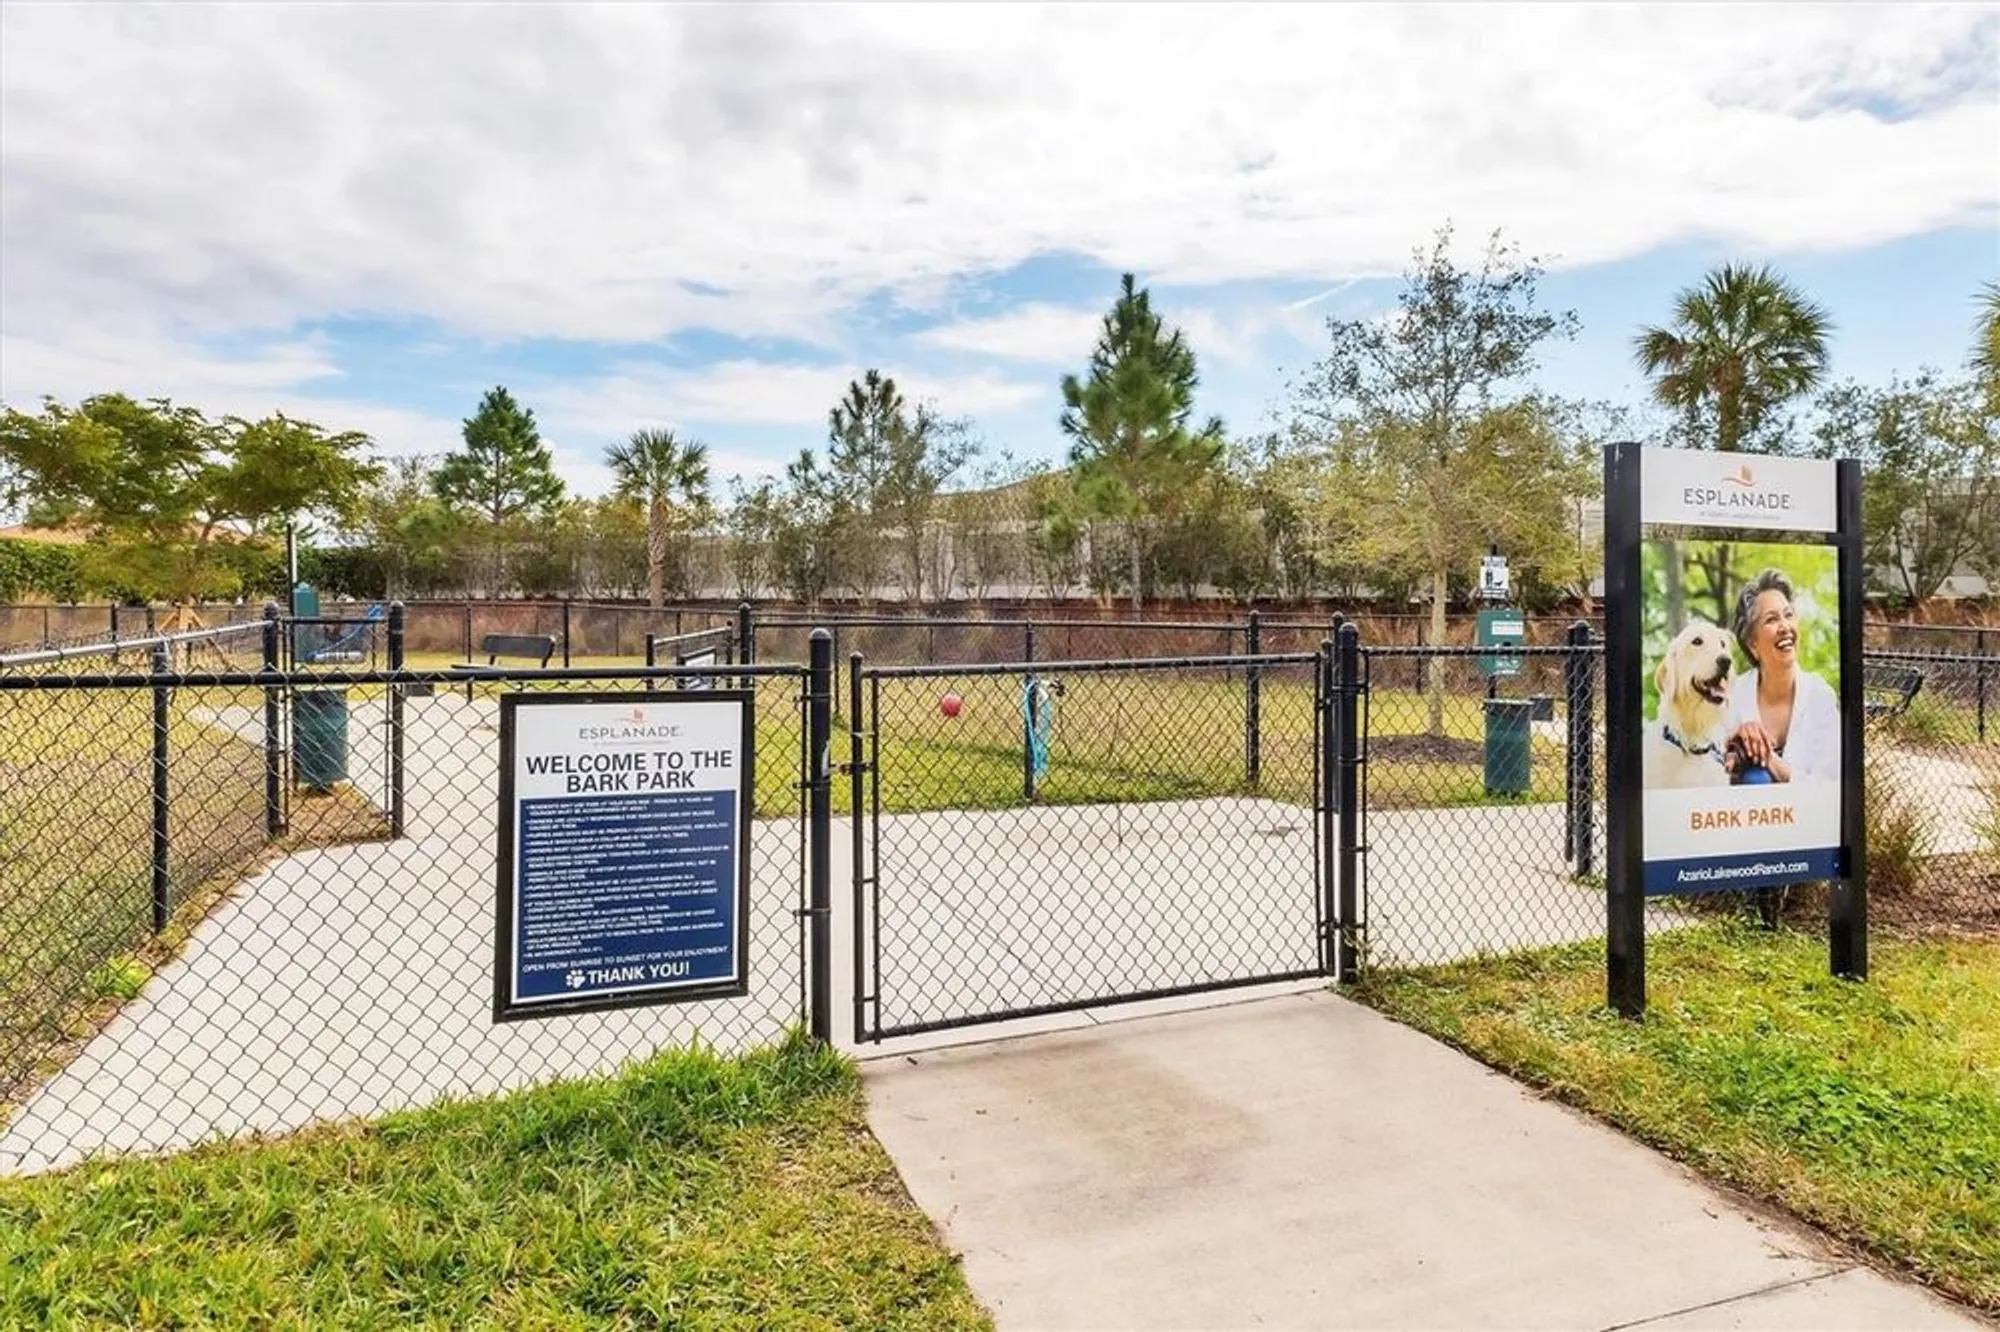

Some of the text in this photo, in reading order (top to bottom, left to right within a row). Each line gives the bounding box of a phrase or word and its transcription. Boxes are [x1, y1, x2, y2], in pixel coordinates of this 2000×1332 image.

[1684, 488, 1791, 510] ESPLANADE
[579, 726, 680, 740] ESPLANADE
[526, 750, 733, 774] WELCOME TO THE
[566, 771, 696, 793] BARK PARK
[1691, 806, 1795, 830] BARK PARK
[1677, 862, 1809, 882] AzarioLakewoodRanch.com
[522, 963, 545, 973] OPEN
[546, 961, 569, 970] FROM
[604, 956, 615, 965] TO
[616, 953, 645, 964] SUNSET
[646, 951, 661, 960] FOR
[663, 949, 683, 959] YOUR
[684, 945, 728, 957] ENJOYMENT
[587, 960, 690, 985] THANK YOU!
